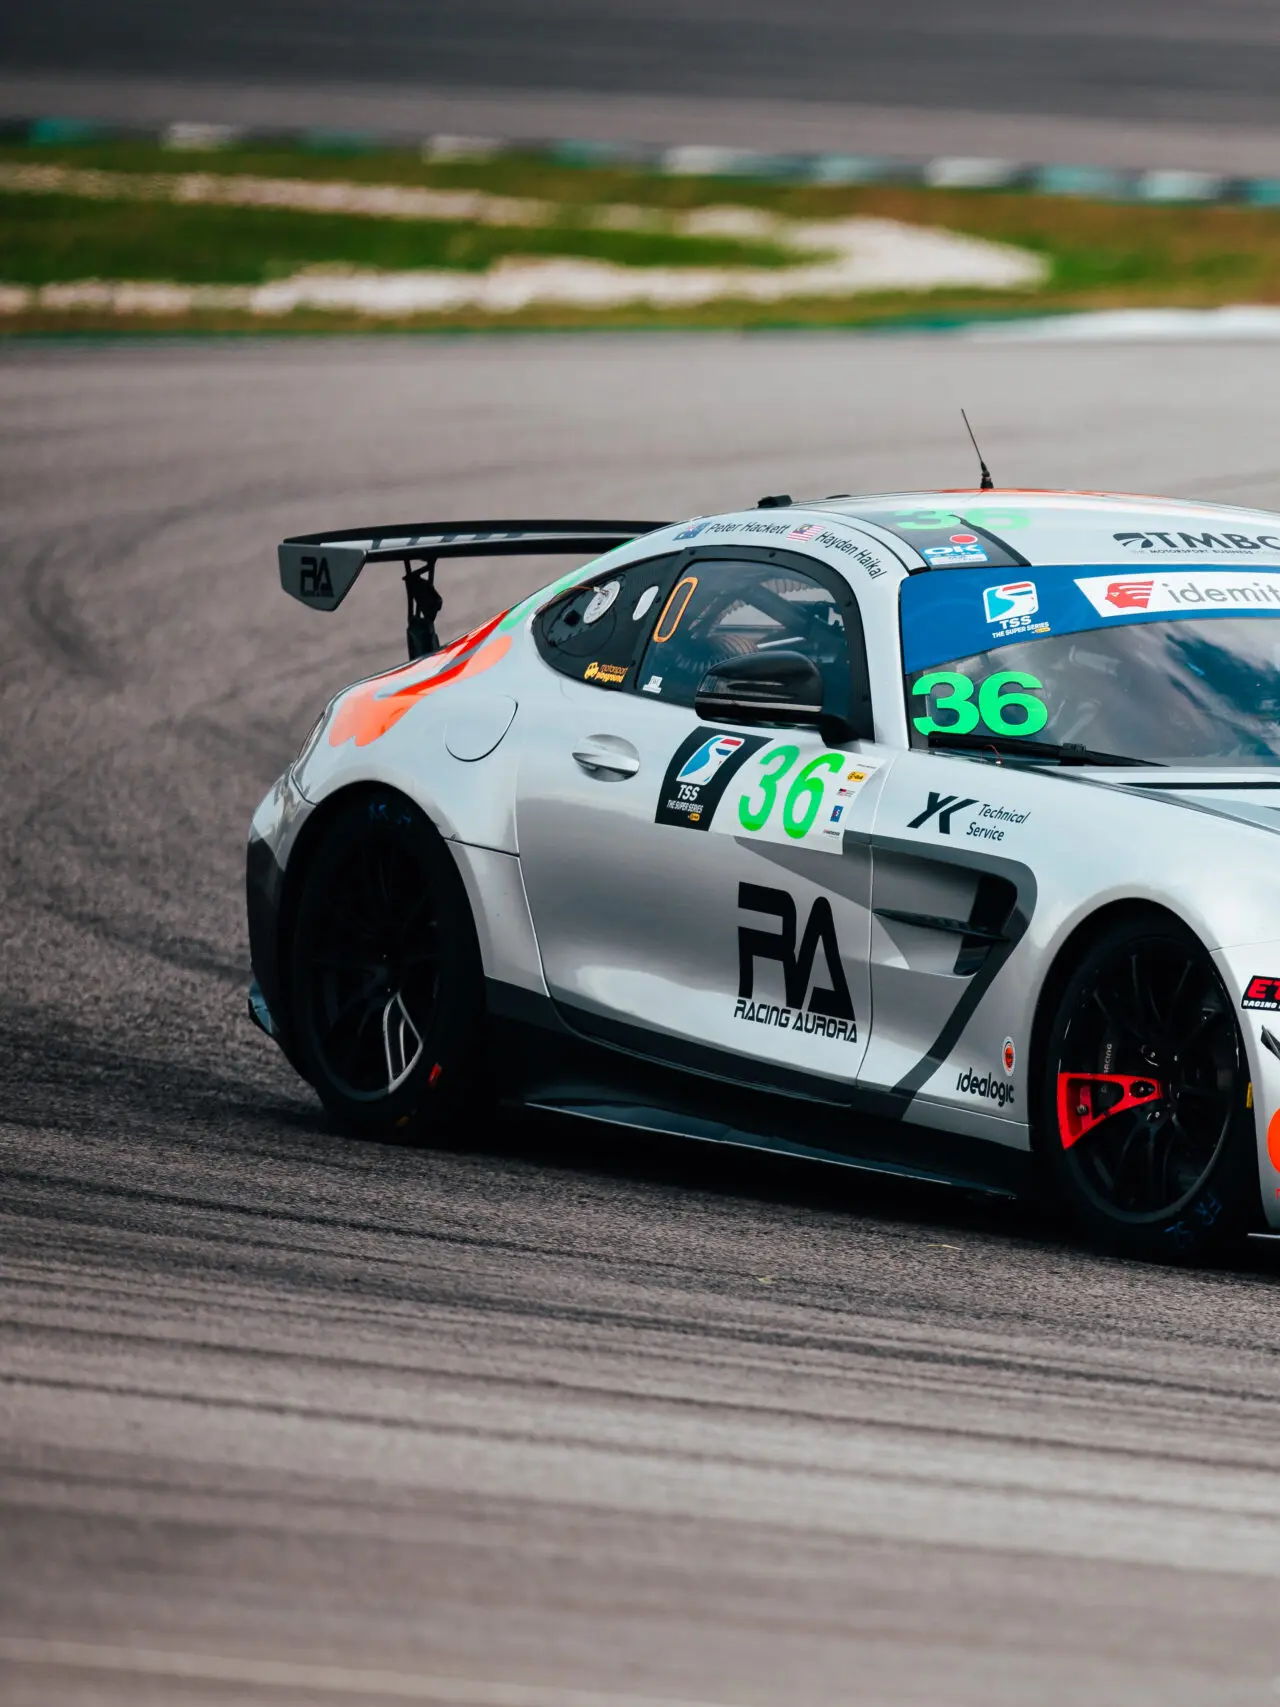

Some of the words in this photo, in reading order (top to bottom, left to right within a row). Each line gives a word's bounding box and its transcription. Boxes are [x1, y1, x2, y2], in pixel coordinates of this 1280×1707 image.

[706, 522, 743, 534] Peter
[743, 522, 791, 535] Hackett
[895, 507, 1032, 530] 36
[814, 531, 859, 556] Hayden
[853, 549, 888, 580] Haikal
[992, 631, 1005, 639] THE
[1005, 625, 1026, 636] SUPER
[1027, 621, 1050, 631] SERIES
[999, 615, 1032, 629] TSS
[912, 671, 1048, 736] 36
[677, 784, 700, 801] TSS
[738, 744, 846, 839] 36
[667, 800, 675, 809] THE
[674, 801, 689, 812] SUPER
[687, 803, 703, 814] SERIES
[978, 803, 1031, 824] Technical
[966, 821, 1005, 841] Service
[1242, 1000, 1278, 1009] RACING
[734, 999, 791, 1028] RACING
[792, 1011, 857, 1043] AURORA
